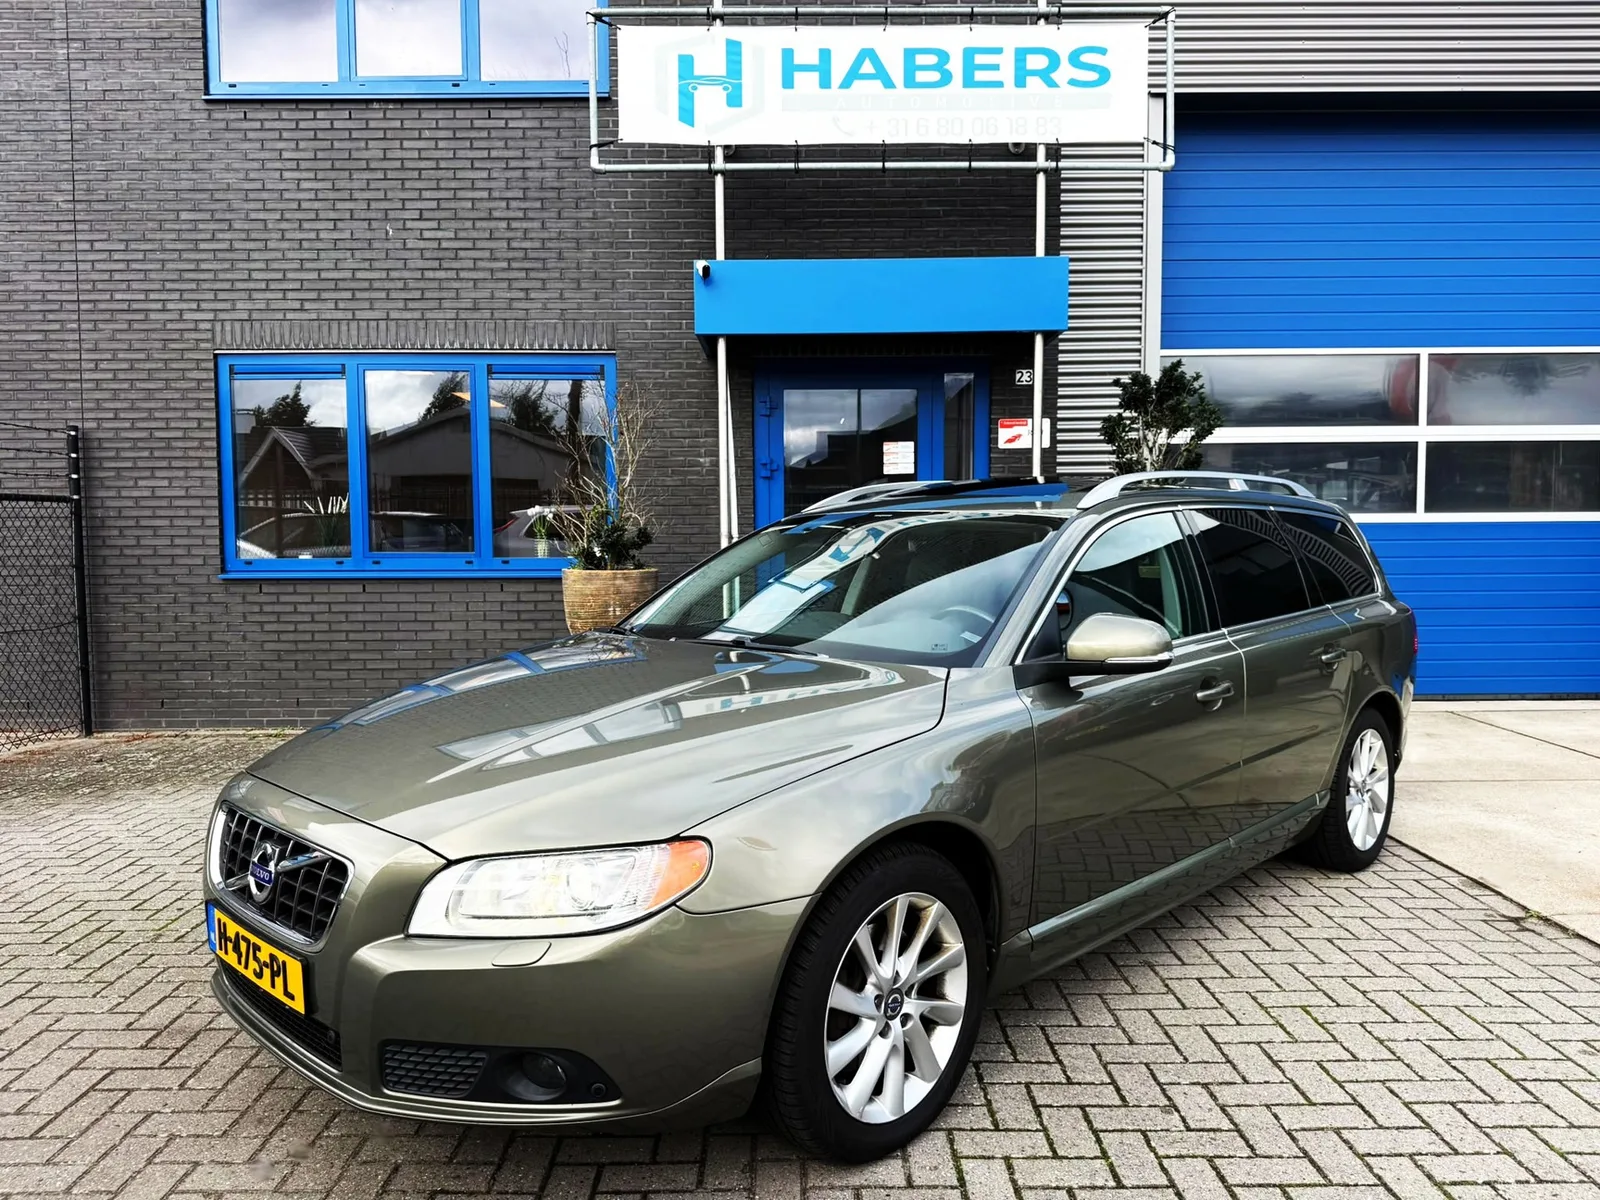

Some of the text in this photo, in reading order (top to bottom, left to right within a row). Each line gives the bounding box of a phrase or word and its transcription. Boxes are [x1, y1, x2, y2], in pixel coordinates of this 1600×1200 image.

[781, 46, 1112, 90] HABERS
[915, 117, 930, 137] 6
[936, 117, 964, 137] 80
[971, 117, 999, 137] 06
[1006, 117, 1028, 137] 18
[1035, 117, 1063, 137] 83
[1016, 370, 1033, 383] 23
[217, 917, 296, 1001] H-475-PL
